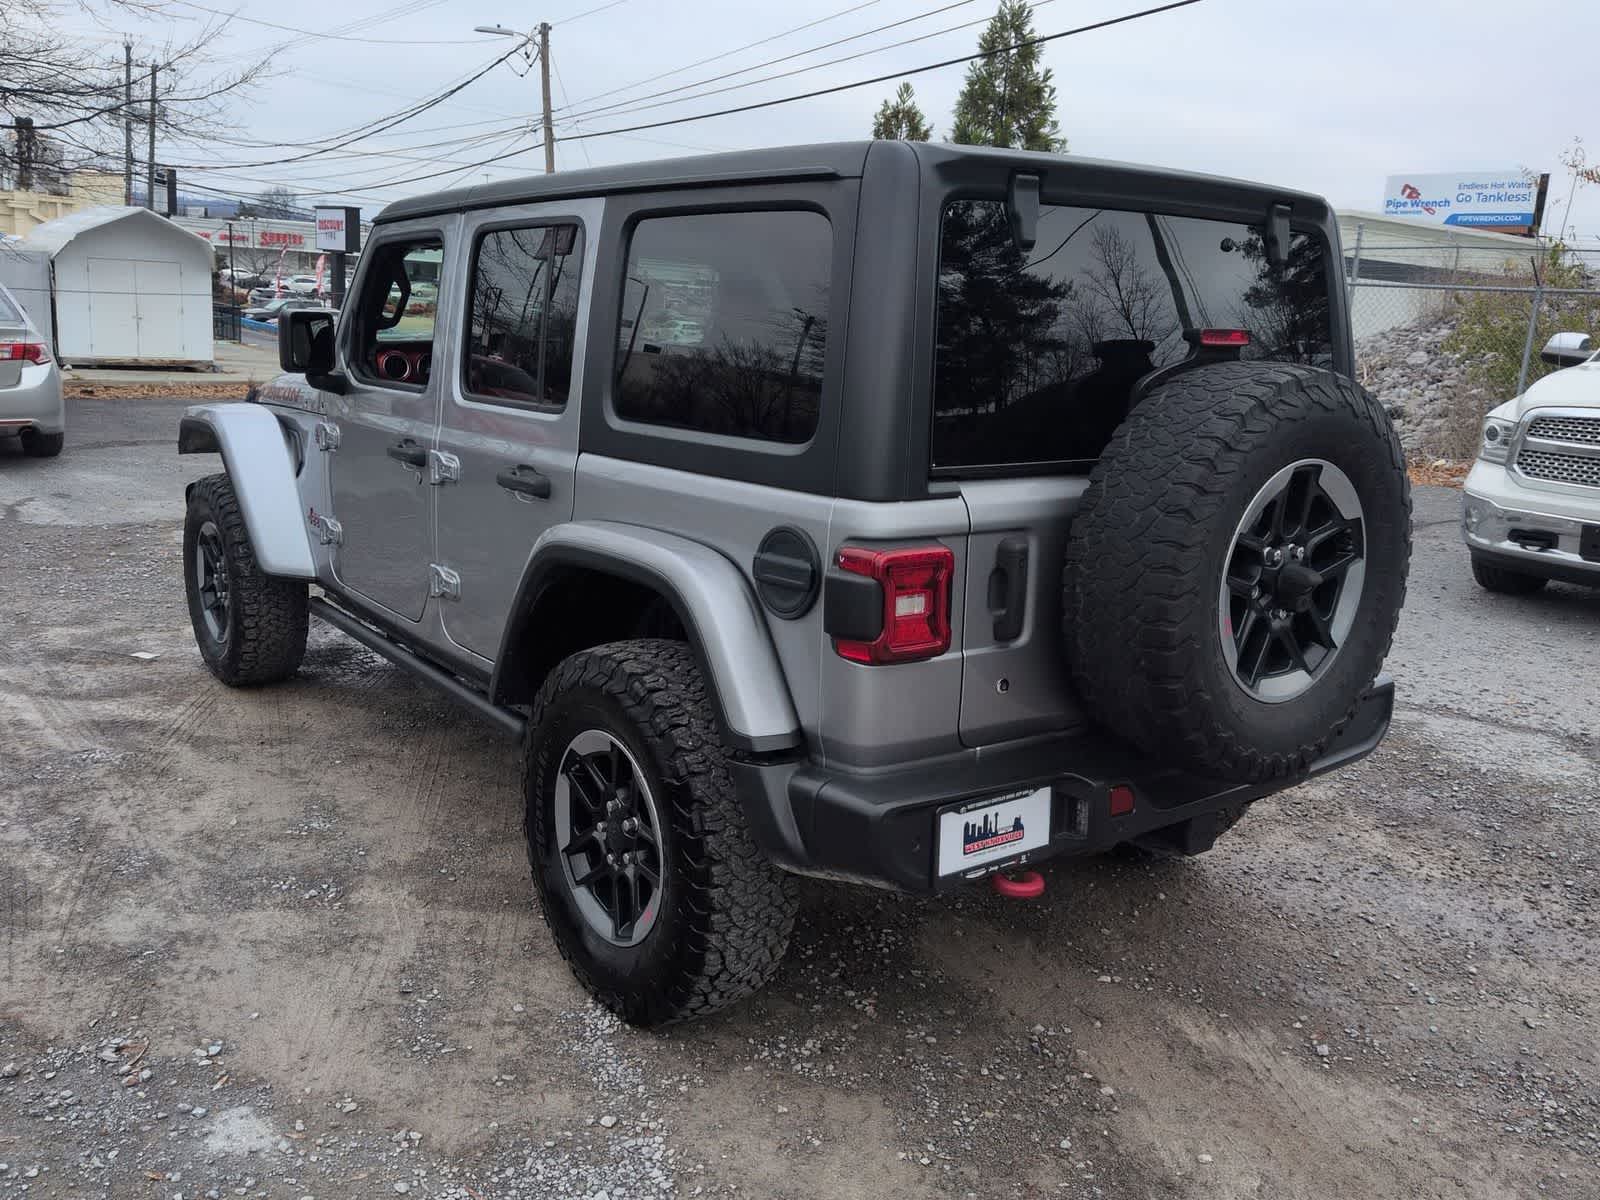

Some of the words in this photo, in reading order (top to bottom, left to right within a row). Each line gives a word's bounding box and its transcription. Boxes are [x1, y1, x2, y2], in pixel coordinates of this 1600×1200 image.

[1458, 182, 1488, 190] Endless
[1490, 181, 1505, 189] Hot
[1456, 192, 1472, 203] Go
[1476, 191, 1532, 202] Tankless!
[1386, 198, 1409, 209] Pipe
[1410, 198, 1450, 208] Wrench
